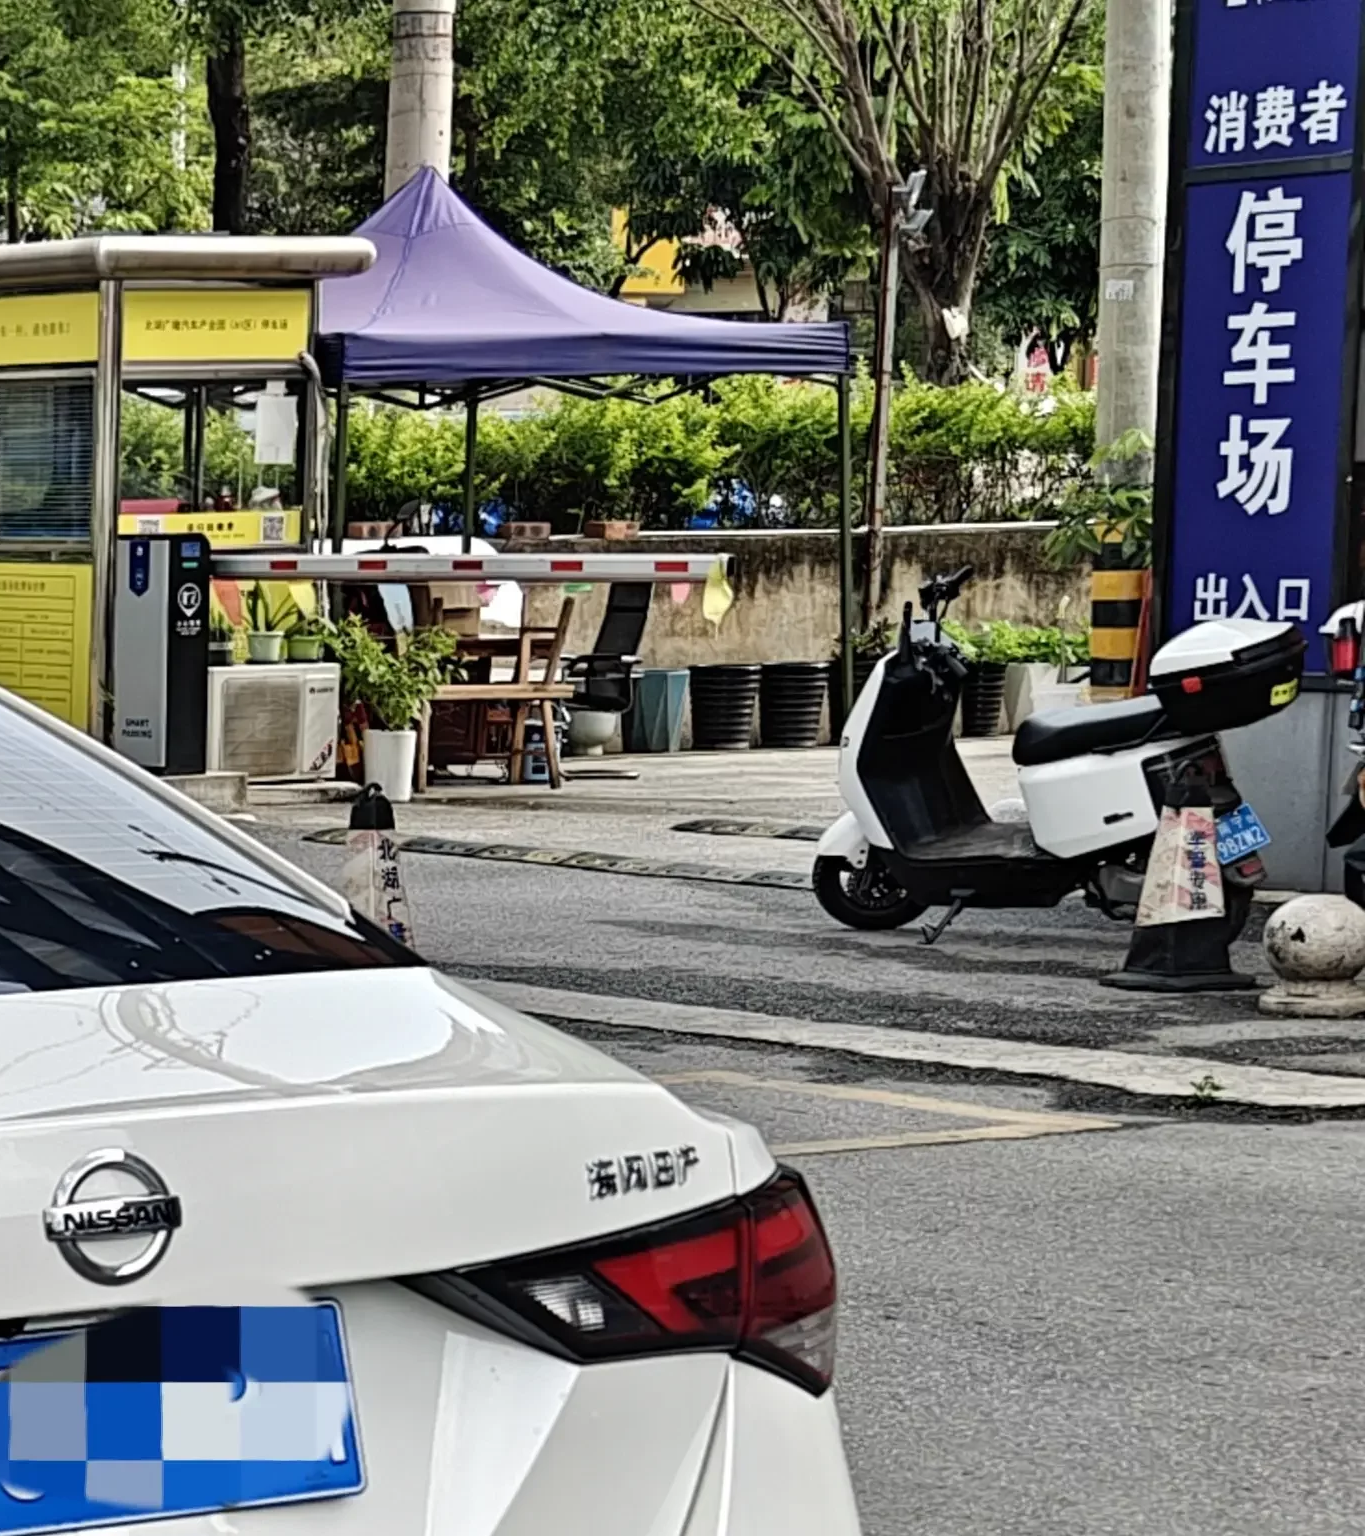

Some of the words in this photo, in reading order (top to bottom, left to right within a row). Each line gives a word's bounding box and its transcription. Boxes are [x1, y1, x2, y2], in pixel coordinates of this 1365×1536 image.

[1204, 80, 1348, 153] 消费者
[1216, 187, 1304, 516] 停车场
[1193, 572, 1311, 622] 出入口
[62, 1203, 175, 1233] NISSAN
